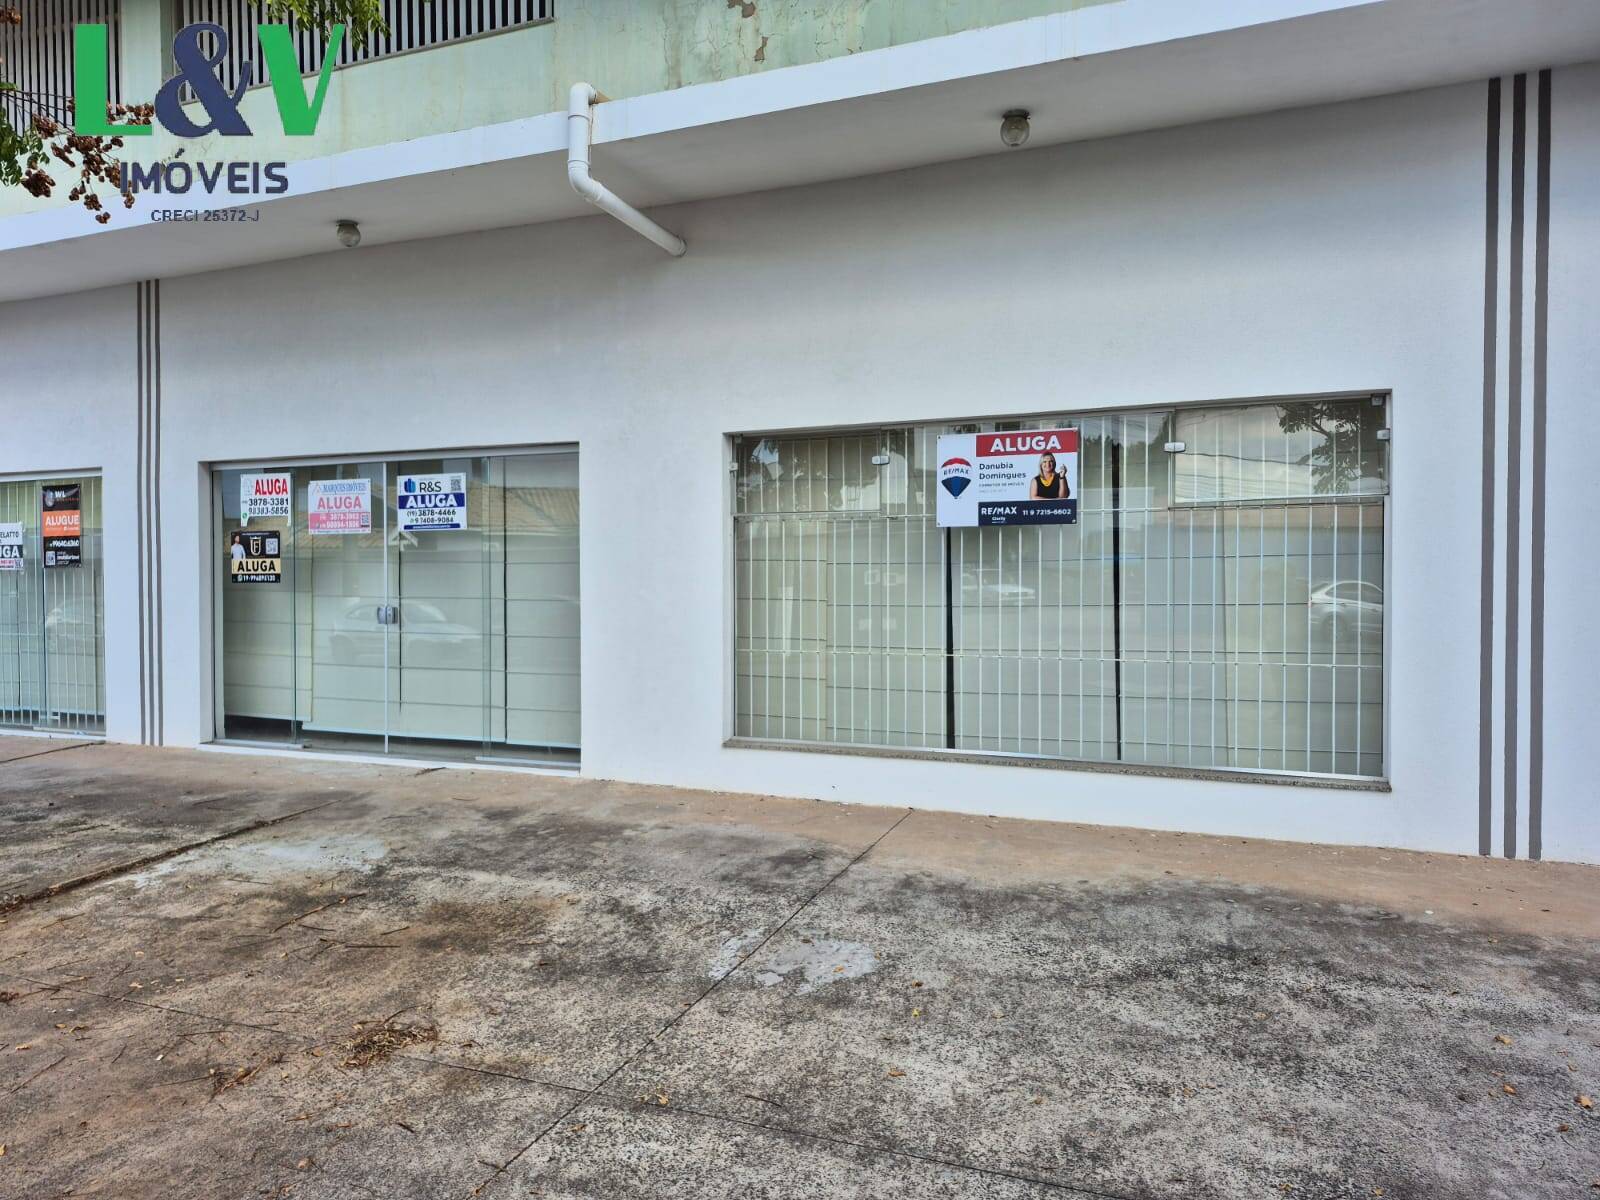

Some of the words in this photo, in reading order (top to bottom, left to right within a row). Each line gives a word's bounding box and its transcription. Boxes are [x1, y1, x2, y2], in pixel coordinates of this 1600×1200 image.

[990, 435, 1062, 453] ALUGA
[979, 461, 1014, 470] Danubia
[943, 467, 970, 476] RE/MAX
[979, 471, 1027, 480] Domingues
[255, 478, 288, 496] ALUGA
[419, 481, 442, 493] R&S
[54, 490, 66, 498] WL
[317, 495, 362, 510] ALUGA
[405, 494, 458, 509] ALUGA
[981, 506, 1018, 515] RE/MAX
[45, 515, 80, 526] ALUGUE
[237, 560, 276, 572] ALUGA
